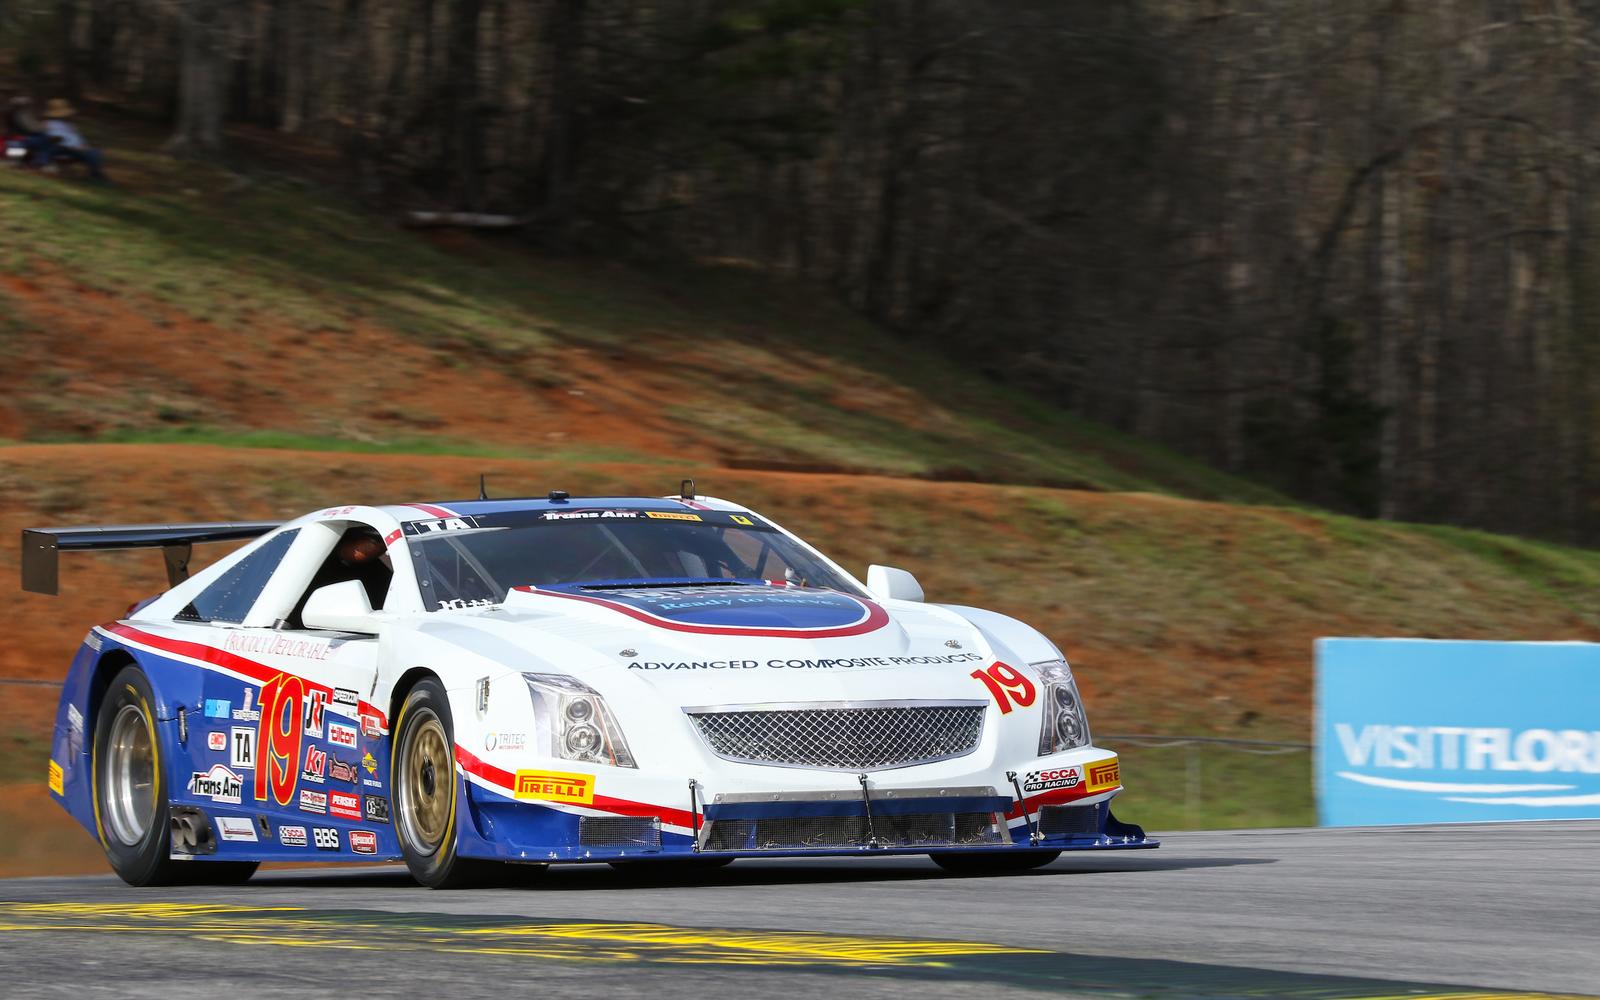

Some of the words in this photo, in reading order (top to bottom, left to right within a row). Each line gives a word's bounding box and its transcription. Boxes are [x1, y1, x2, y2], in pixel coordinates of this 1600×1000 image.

[421, 517, 472, 532] TA
[543, 511, 600, 521] Trans
[601, 510, 637, 520] Am
[658, 599, 732, 611] Ready
[628, 660, 759, 671] ADVANCED
[767, 655, 887, 670] COMPOSITE
[891, 652, 984, 667] PRODUCTS
[969, 660, 1037, 715] 19
[235, 732, 251, 763] TA
[254, 672, 306, 807] 19
[499, 733, 526, 745] TRITEC
[304, 745, 327, 777] K1
[1040, 768, 1078, 781] SCCA
[194, 773, 222, 795] Trans
[222, 776, 240, 798] Am
[518, 775, 587, 798] PIRELLI
[1025, 782, 1043, 791] PRO
[1044, 778, 1077, 788] RACING
[286, 829, 304, 837] SCCA
[313, 828, 340, 848] BBS
